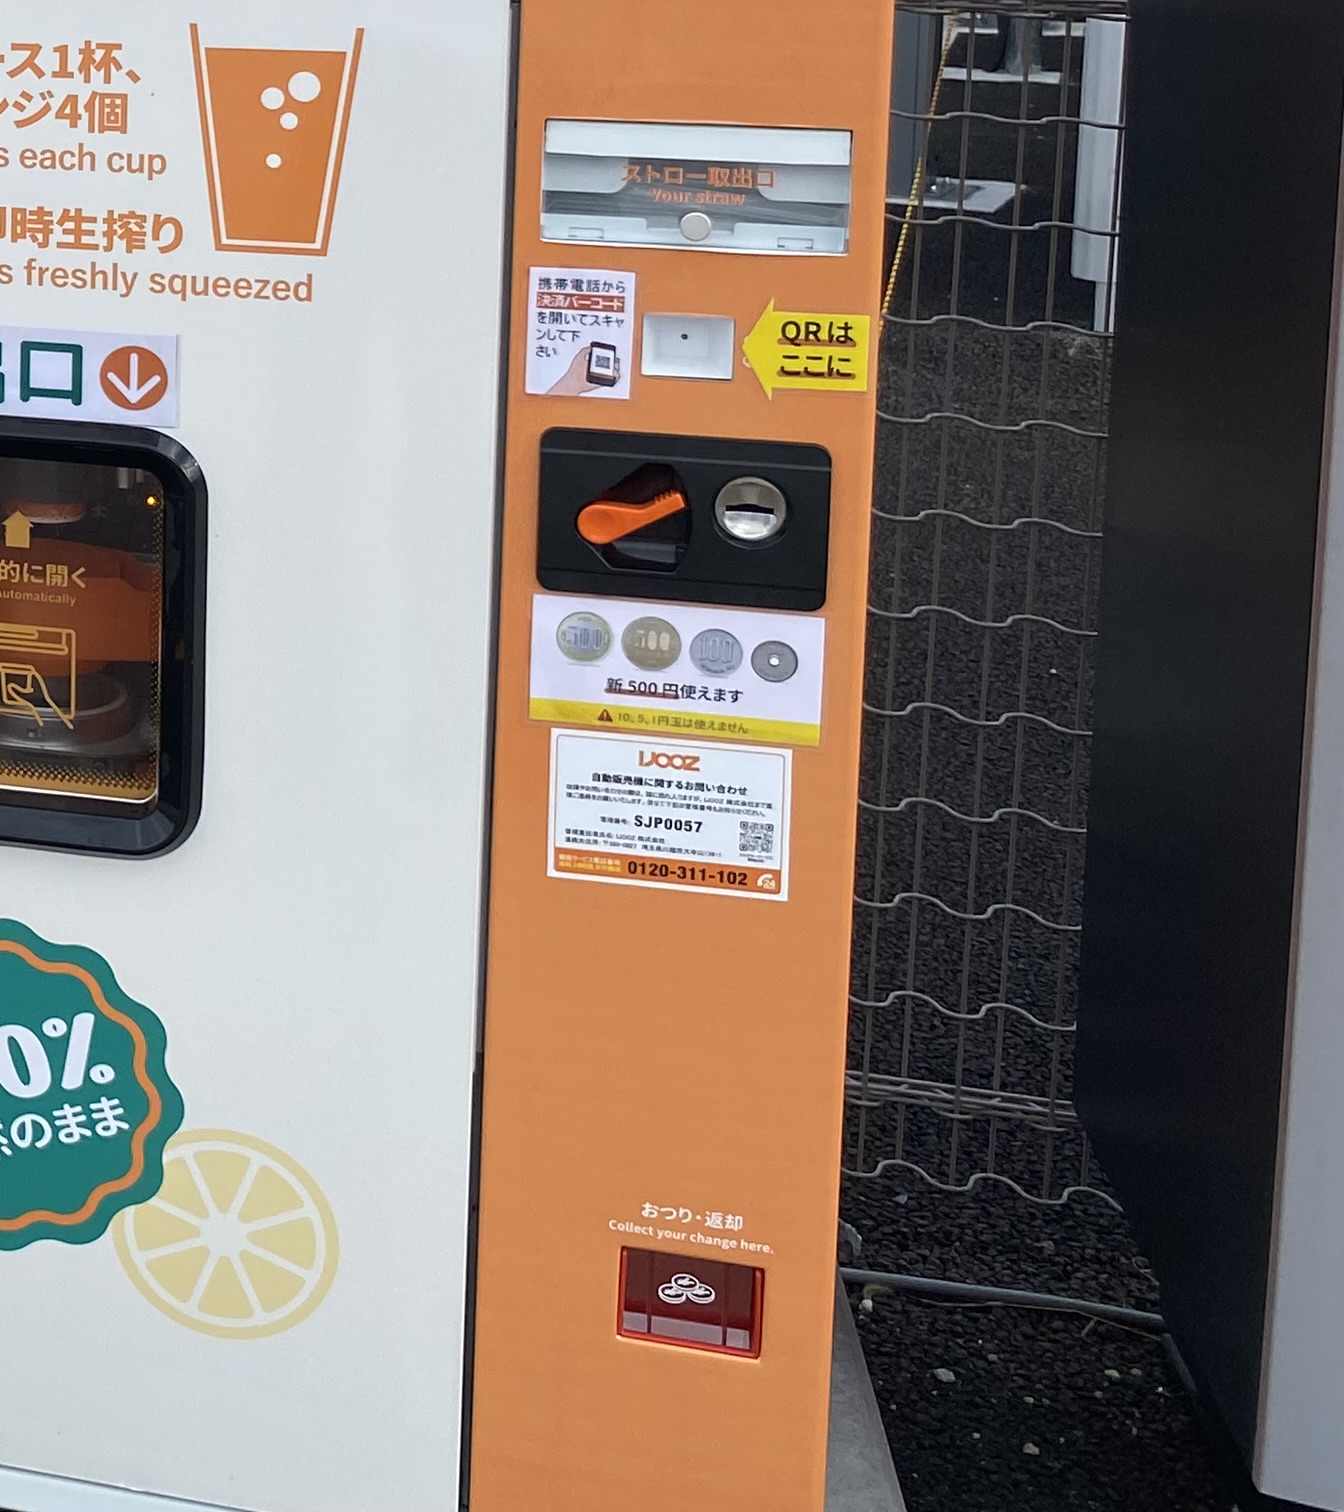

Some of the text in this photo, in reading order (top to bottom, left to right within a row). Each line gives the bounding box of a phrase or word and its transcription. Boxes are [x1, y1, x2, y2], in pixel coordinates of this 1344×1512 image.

[19, 142, 96, 173] each
[109, 149, 168, 181] cup
[621, 164, 775, 188] ストロー取出口
[24, 258, 139, 299] freshly
[149, 272, 313, 313] squeezed
[538, 276, 626, 294] 携帯電話から
[536, 293, 623, 310] 決済バーコード
[537, 311, 624, 327] を開いてスキャ
[536, 328, 580, 342] ンして下
[781, 320, 854, 346] QRは
[536, 345, 557, 358] さい
[780, 354, 852, 376] ここに
[591, 772, 748, 796] 自動販売機に関するお問い合わせ
[634, 815, 703, 833] SJP0057
[628, 861, 748, 886] 0120-311-102
[641, 1201, 743, 1232] おつり・返却
[609, 1219, 774, 1255] Collect your change here.
